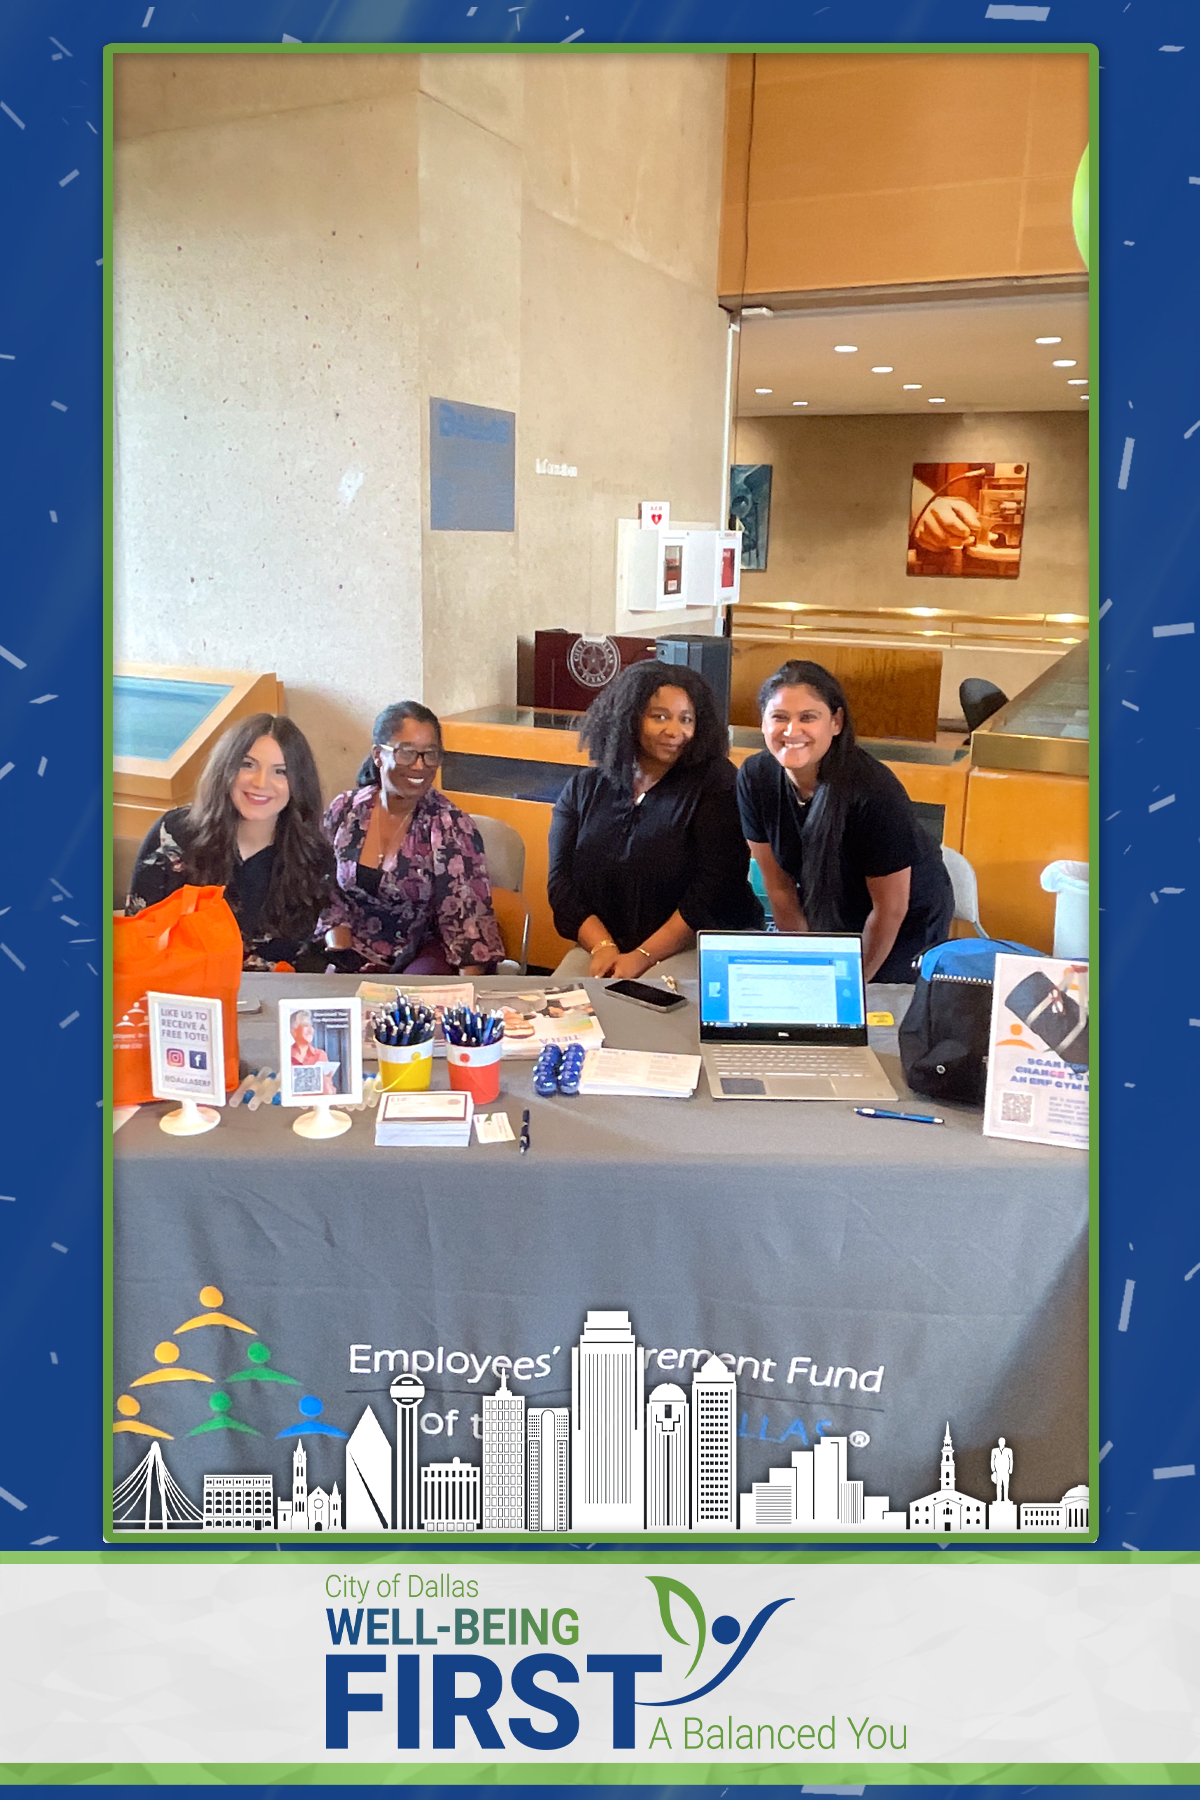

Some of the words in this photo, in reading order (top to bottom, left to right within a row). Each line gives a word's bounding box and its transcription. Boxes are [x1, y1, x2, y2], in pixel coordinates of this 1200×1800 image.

[161, 1009, 178, 1018] LIKE
[181, 1011, 193, 1020] US
[195, 1012, 207, 1021] TO
[161, 1019, 197, 1031] RECEIVE
[161, 1029, 182, 1040] FREE
[1027, 1057, 1062, 1068] SCAN
[1015, 1066, 1065, 1079] CHANCE
[1010, 1075, 1027, 1083] AN
[1055, 1081, 1082, 1090] GYM
[645, 1346, 777, 1383] rement
[786, 1356, 885, 1393] Fund
[420, 1409, 460, 1437] of
